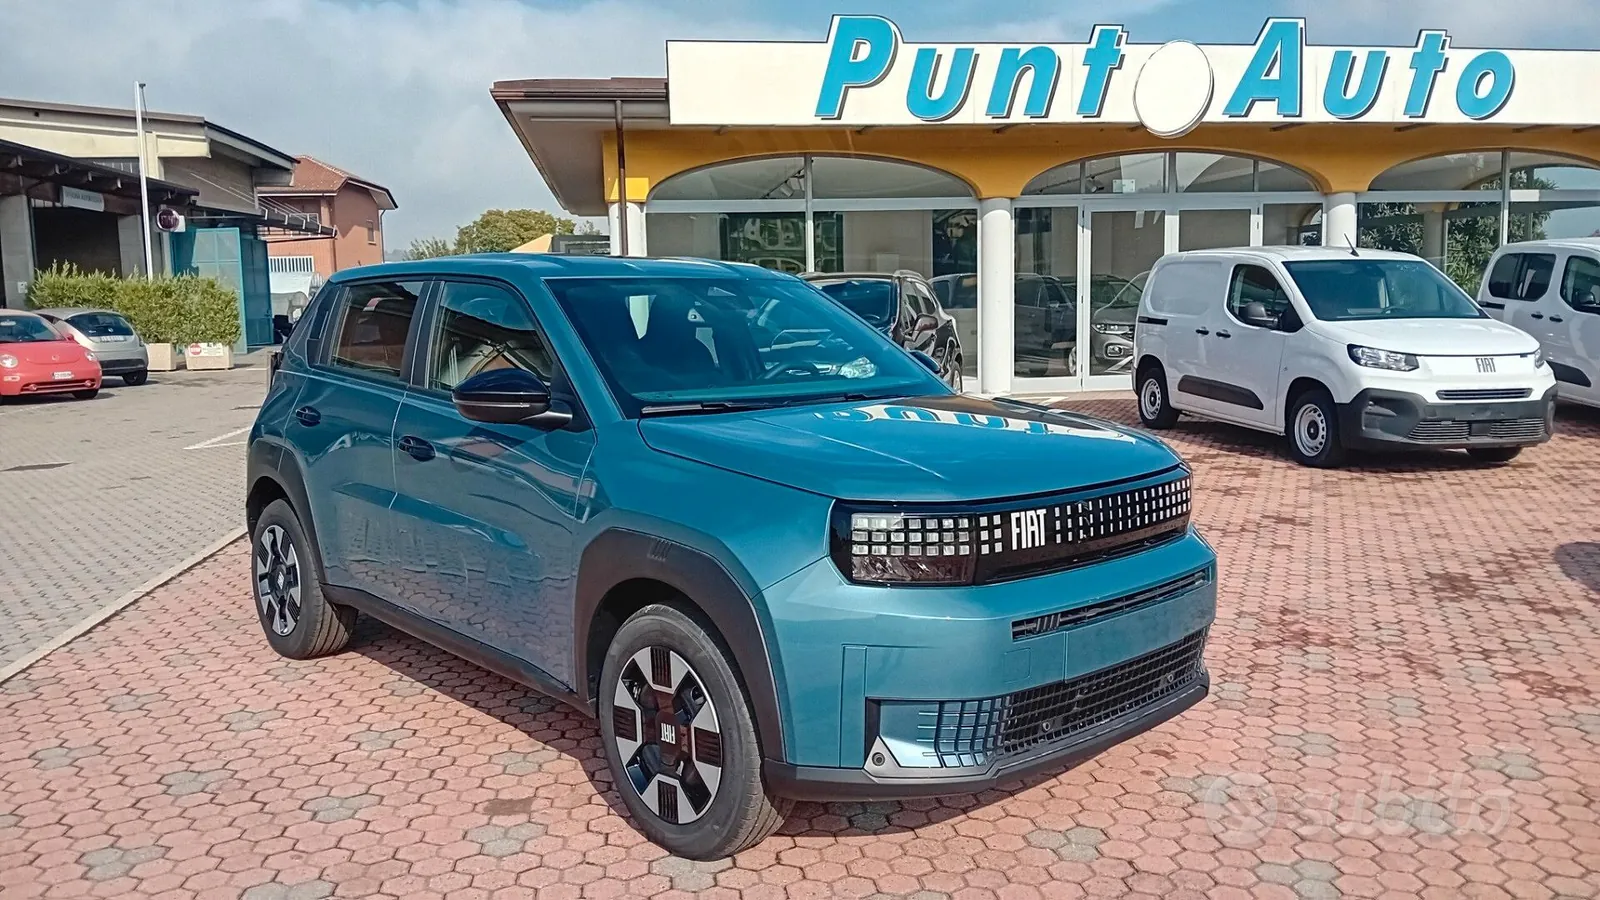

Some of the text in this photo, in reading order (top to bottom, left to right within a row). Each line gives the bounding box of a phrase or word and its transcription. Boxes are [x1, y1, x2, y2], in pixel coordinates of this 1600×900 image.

[1222, 17, 1515, 121] Auto
[1475, 357, 1497, 373] FIAT
[1010, 508, 1047, 550] FIAT
[660, 722, 676, 745] FIAT
